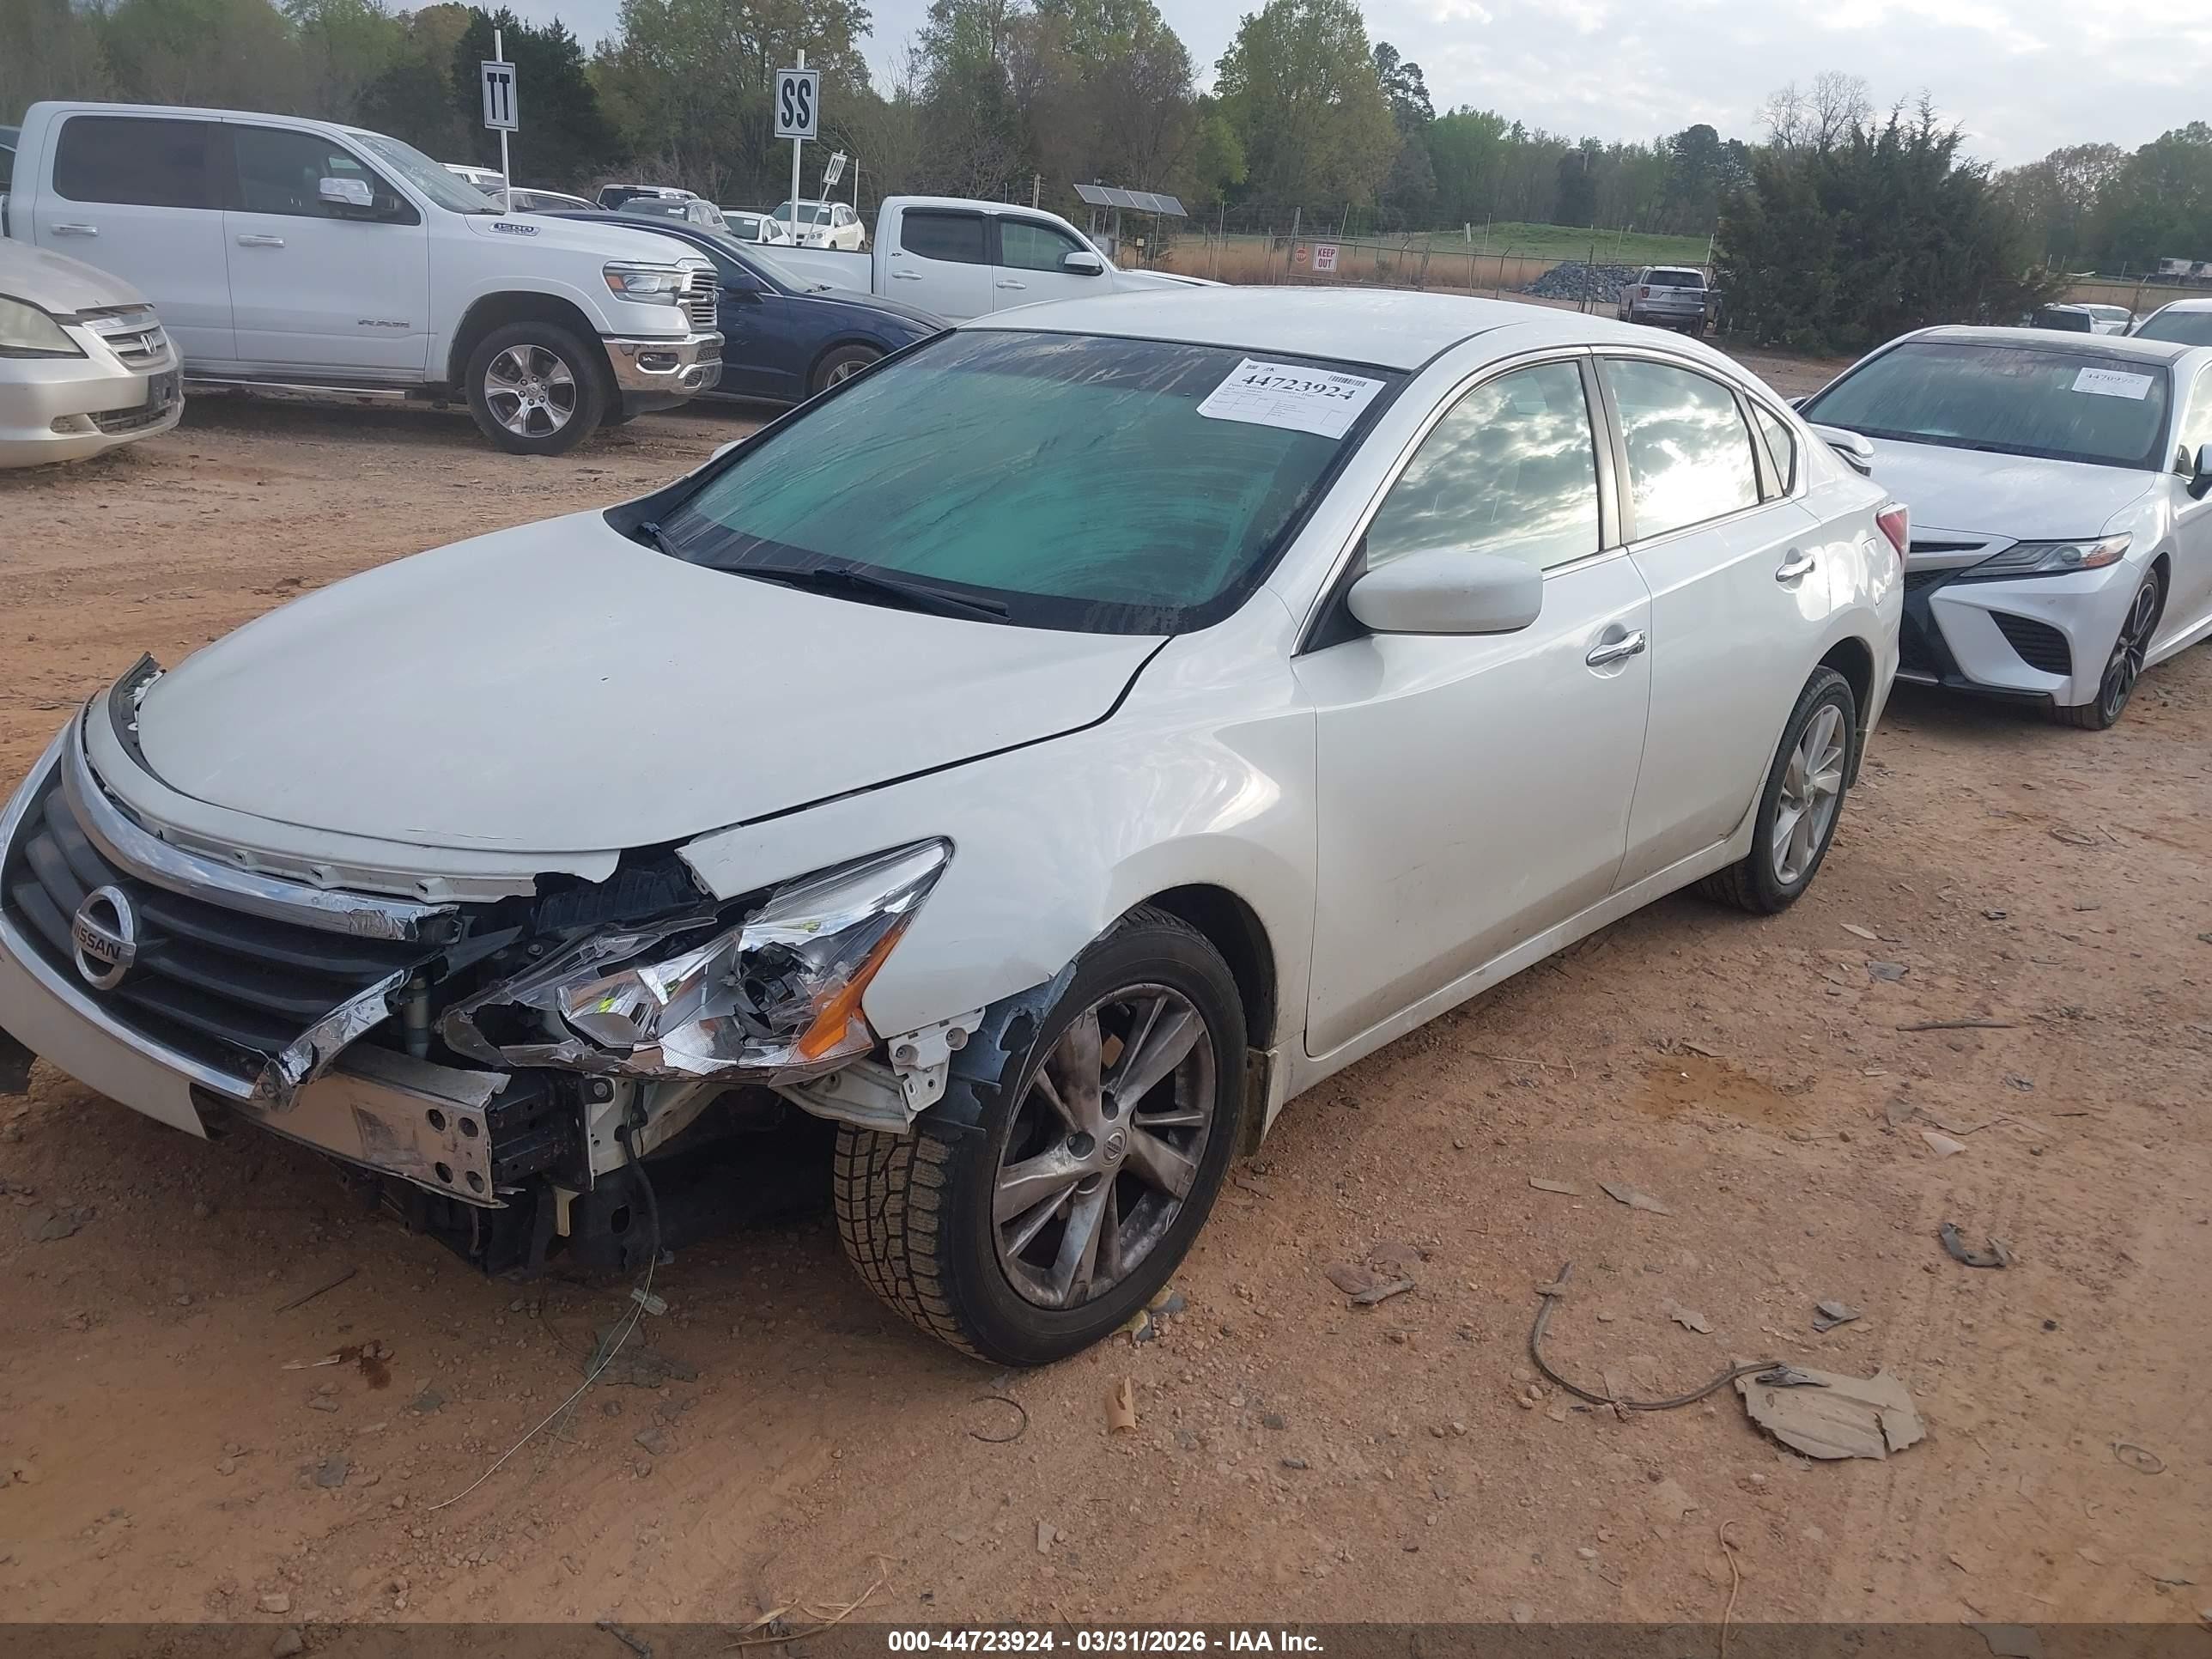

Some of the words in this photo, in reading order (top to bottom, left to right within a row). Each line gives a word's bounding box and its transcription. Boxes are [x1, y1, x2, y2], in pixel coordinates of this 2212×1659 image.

[487, 72, 510, 120] TT
[781, 77, 811, 129] SS
[1317, 247, 1335, 258] KEEP
[1318, 258, 1332, 269] OUT
[1242, 374, 1356, 400] 44723924
[74, 922, 120, 960] NISSAN
